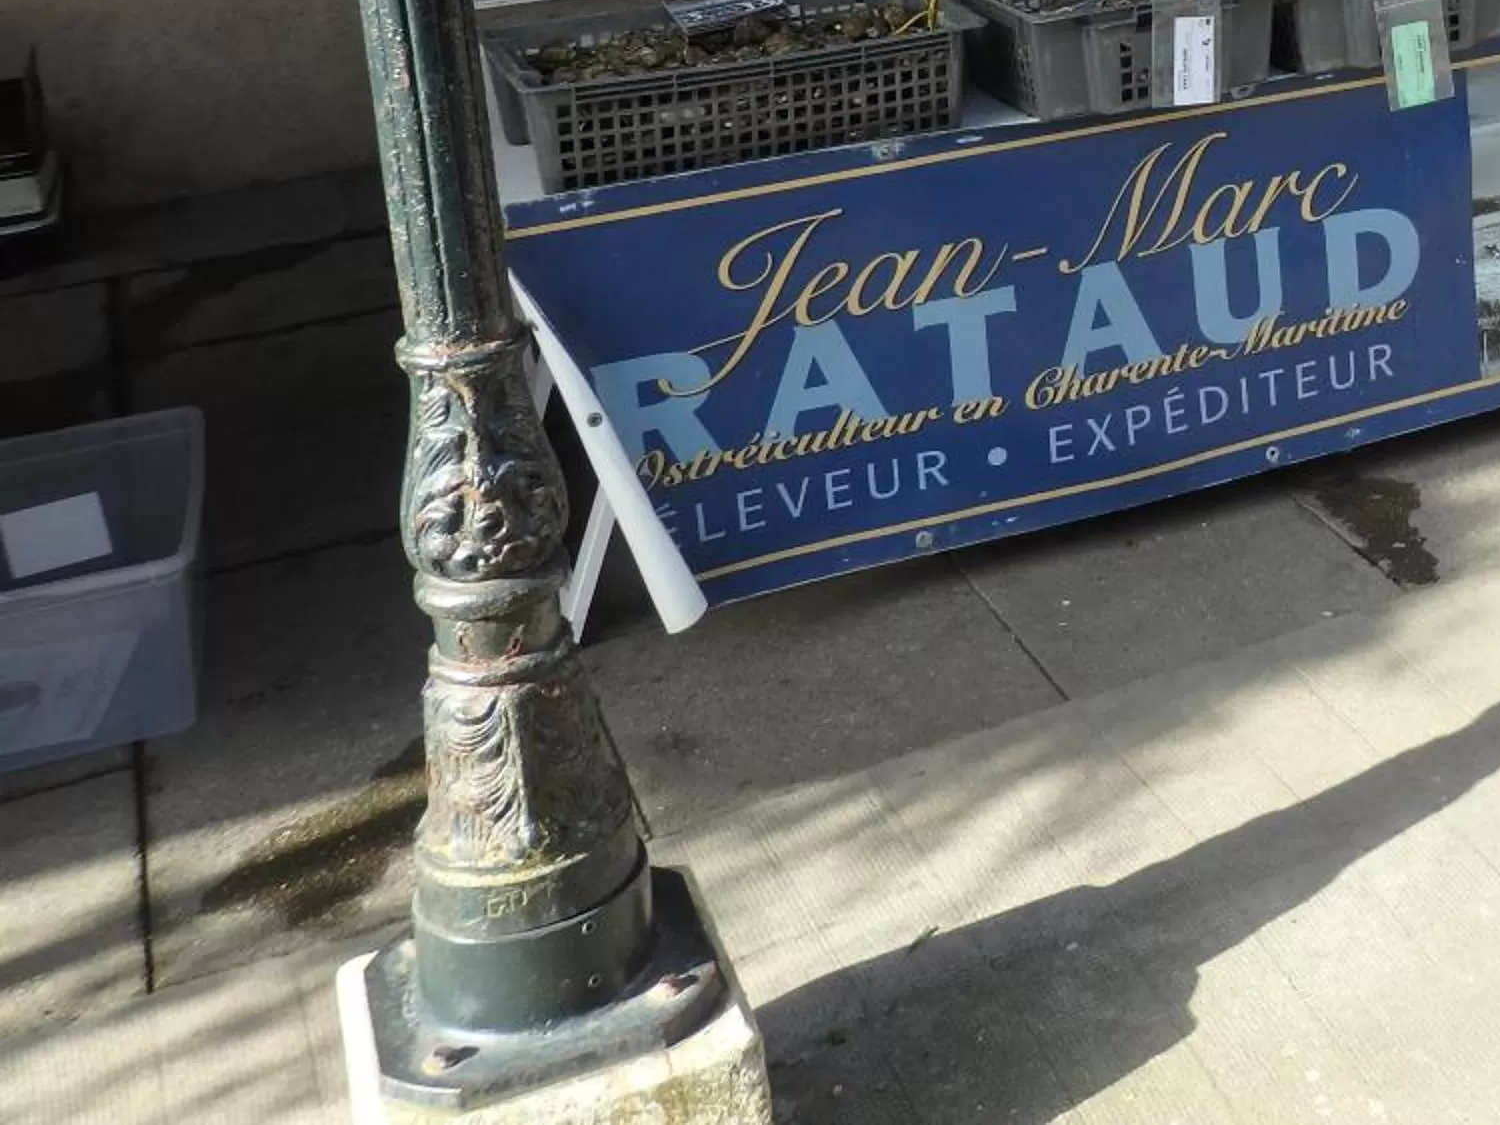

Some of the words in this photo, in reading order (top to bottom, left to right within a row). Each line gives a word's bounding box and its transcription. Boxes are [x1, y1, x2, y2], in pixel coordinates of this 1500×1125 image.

[590, 207, 1422, 467] RATAUD
[634, 405, 945, 492] Ostréiculteur
[952, 392, 1011, 426] en
[1024, 296, 1409, 411] Charente-Maritime
[1047, 342, 1396, 465] EXPÉDITEUR
